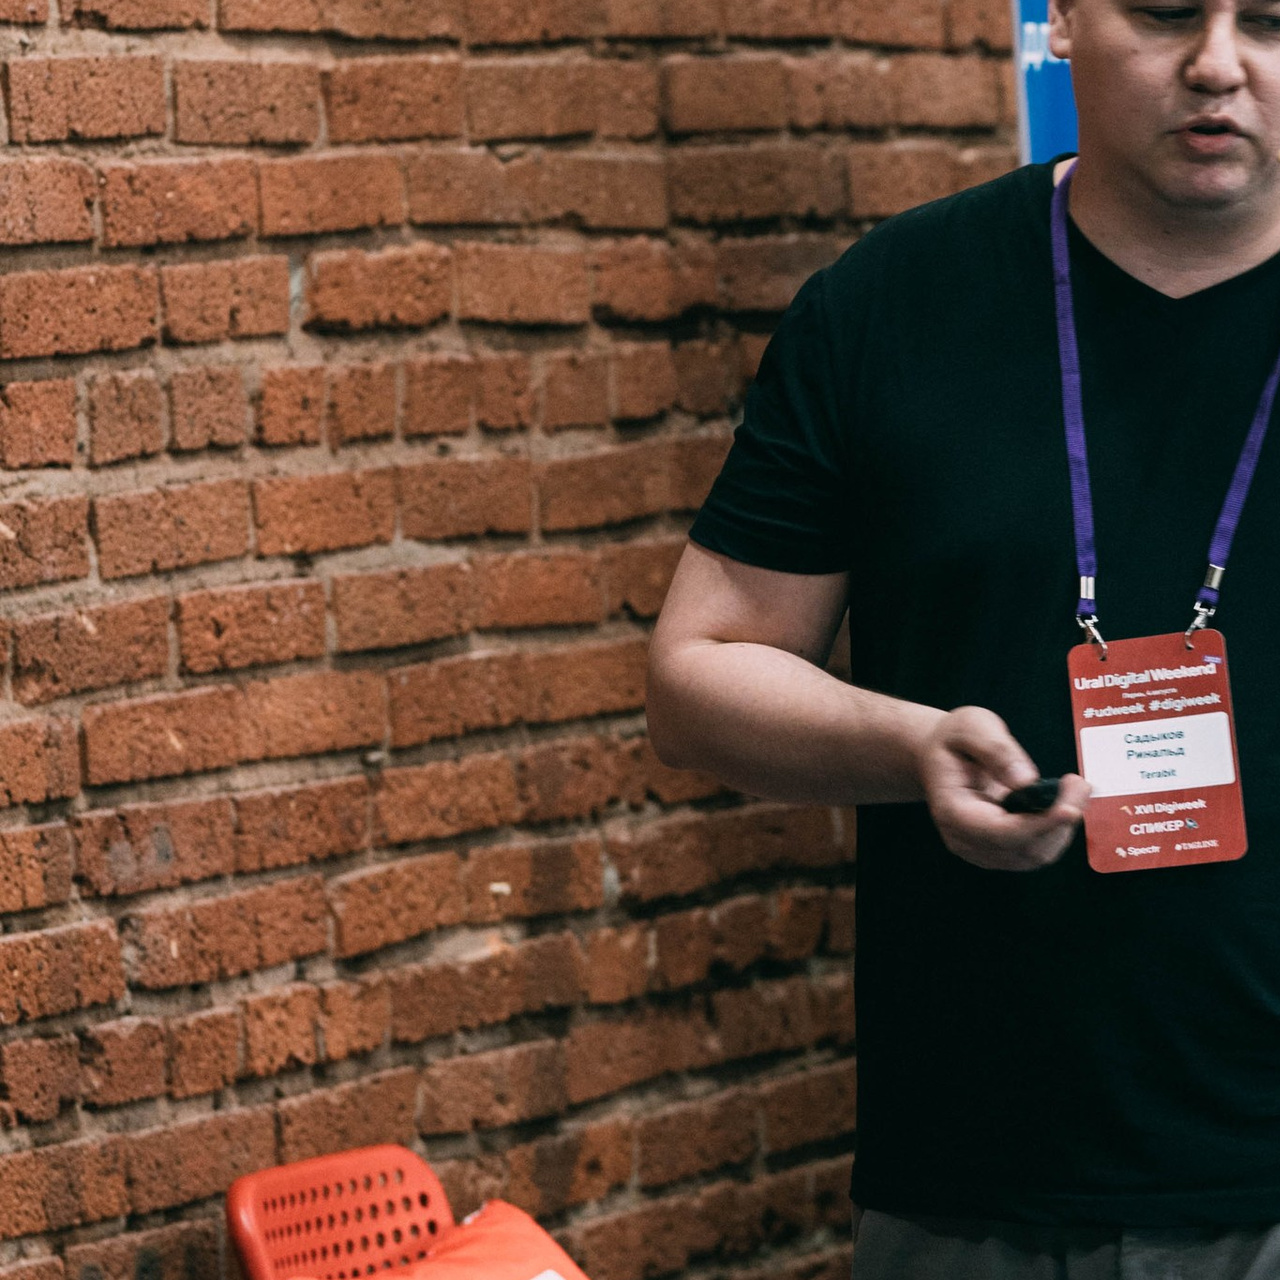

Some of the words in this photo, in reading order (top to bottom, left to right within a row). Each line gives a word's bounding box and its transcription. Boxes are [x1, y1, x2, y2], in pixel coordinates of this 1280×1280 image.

[1074, 675, 1105, 691] Ural
[1105, 670, 1150, 689] Digital
[1150, 662, 1217, 681] Weekend
[1083, 703, 1146, 719] #udweek
[1148, 692, 1222, 712] #digiweek
[1124, 730, 1184, 744] Садыков
[1155, 798, 1207, 814] Digiweek
[1129, 820, 1185, 835] СПИКЕР
